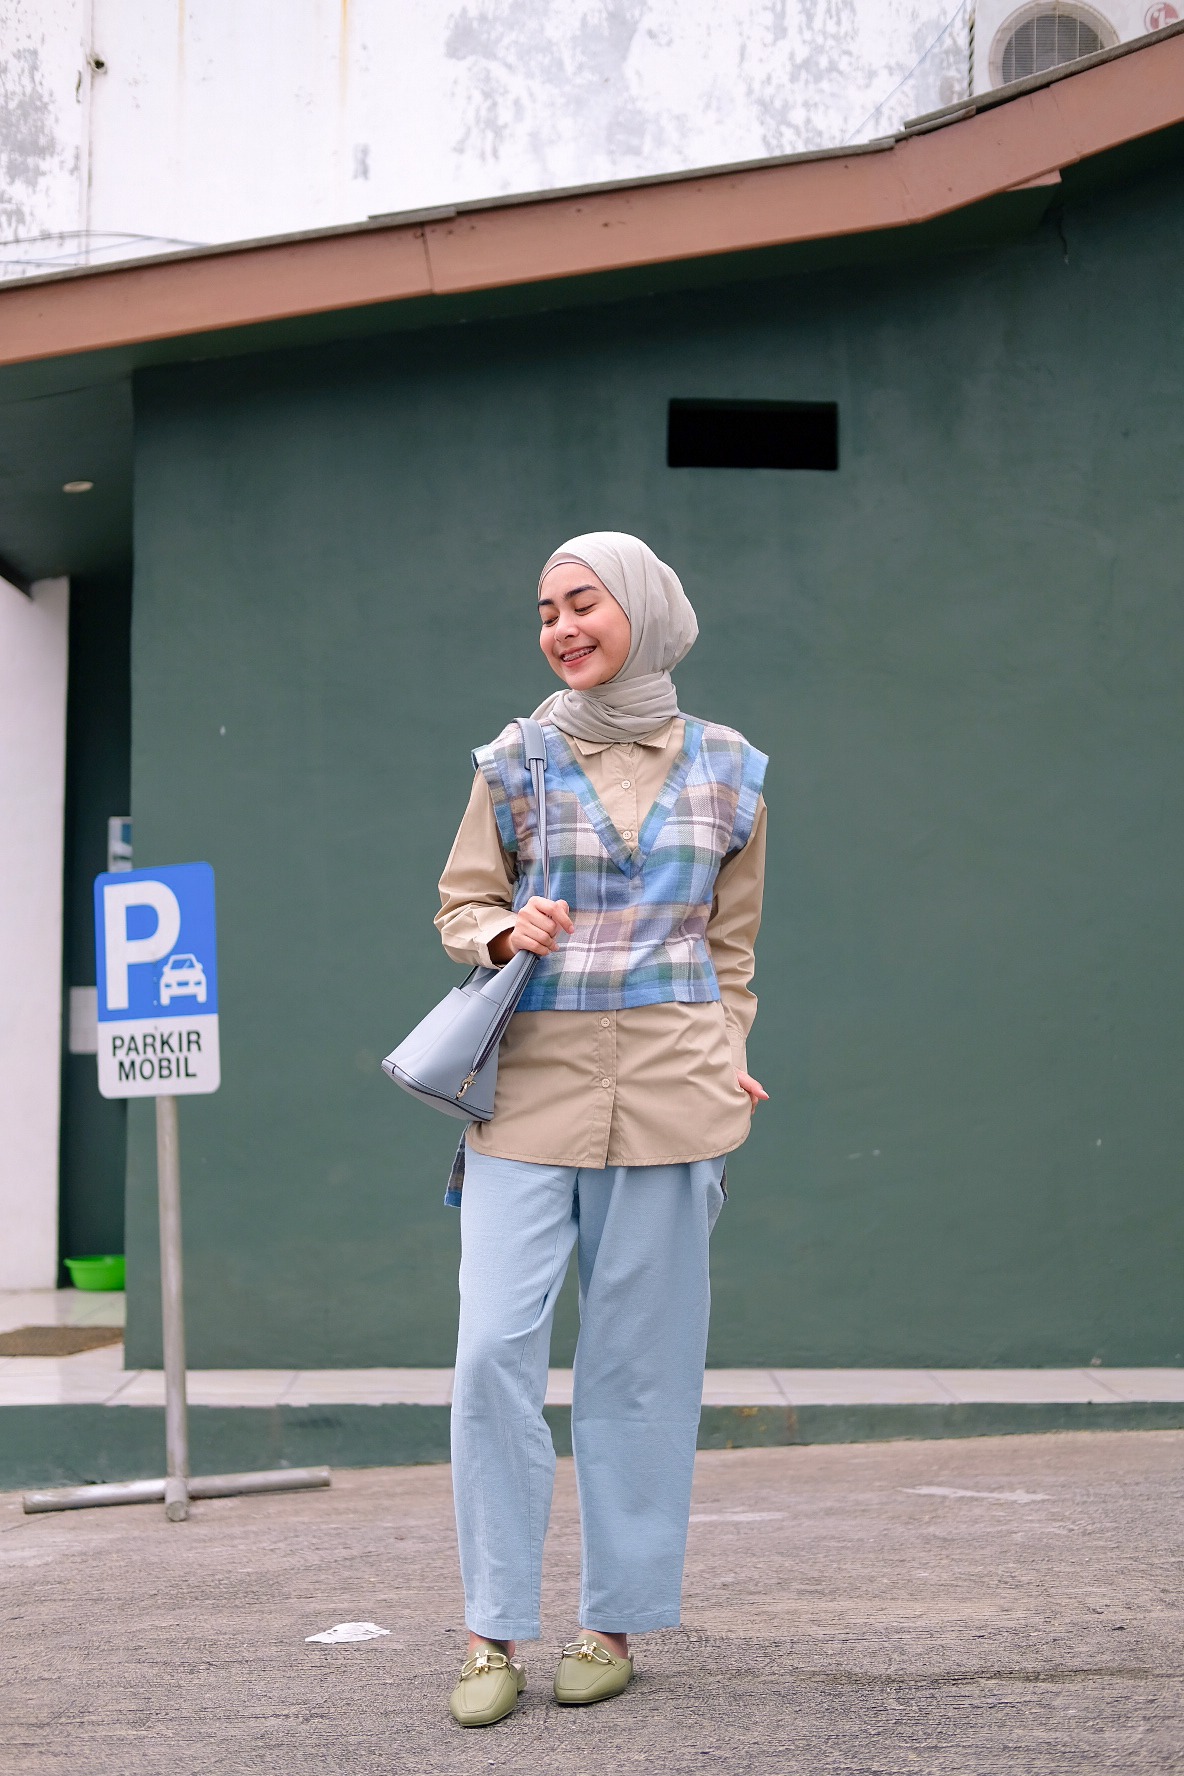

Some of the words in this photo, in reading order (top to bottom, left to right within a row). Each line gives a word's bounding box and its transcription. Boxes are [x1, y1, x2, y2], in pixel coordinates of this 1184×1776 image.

[103, 880, 181, 1011] P
[112, 1030, 202, 1057] PARKIR
[118, 1056, 197, 1081] MOBIL
